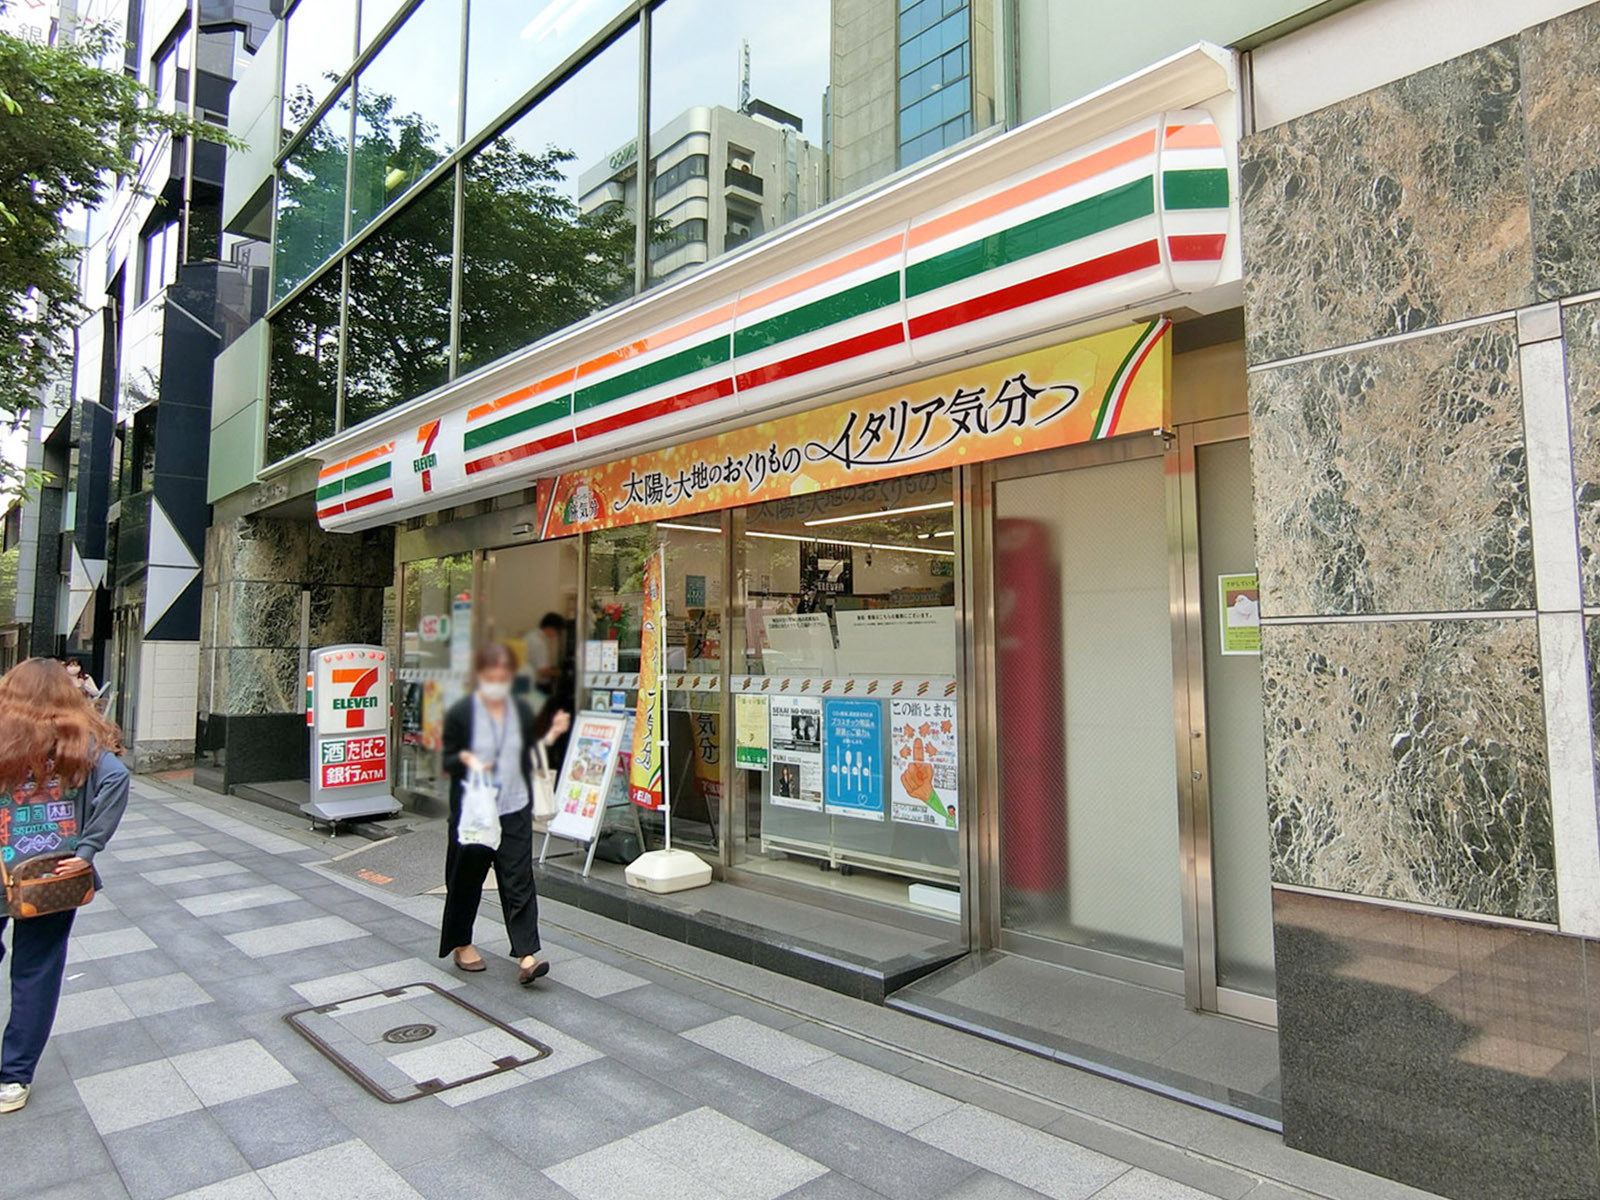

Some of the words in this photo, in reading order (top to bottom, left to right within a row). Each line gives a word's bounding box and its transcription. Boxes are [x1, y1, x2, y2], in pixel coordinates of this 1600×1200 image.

[614, 447, 800, 511] 太陽と大地のおくりもの
[804, 373, 1080, 469] イタリア気分
[892, 702, 953, 718] この街とまれ
[323, 742, 346, 764] 酒
[347, 739, 385, 760] たばこ
[326, 764, 384, 784] 銀行ATM
